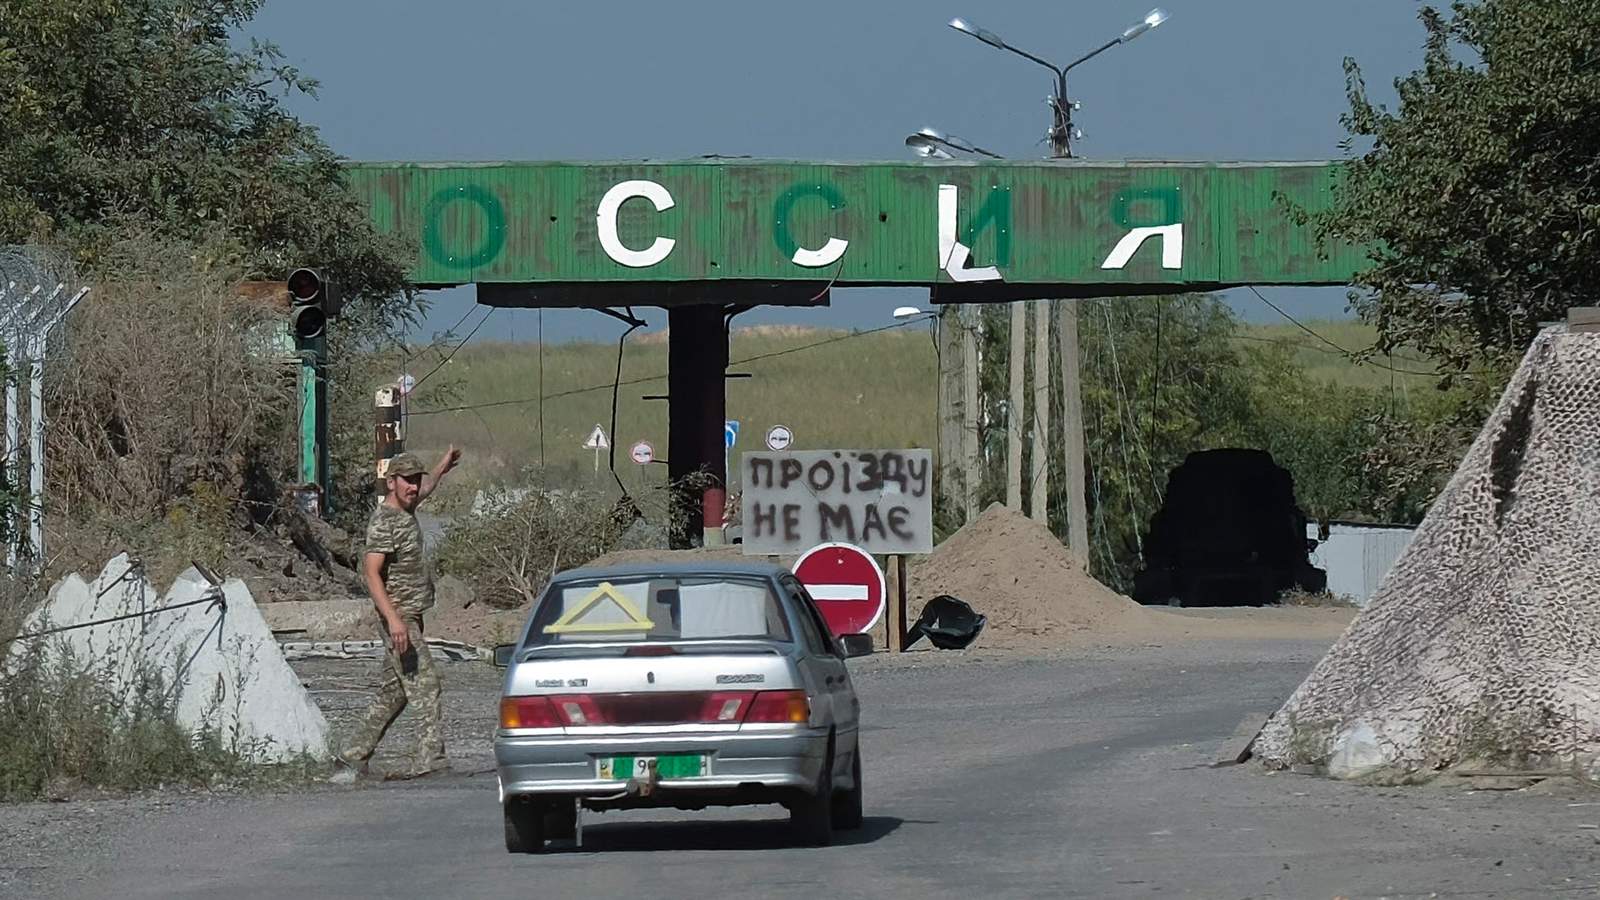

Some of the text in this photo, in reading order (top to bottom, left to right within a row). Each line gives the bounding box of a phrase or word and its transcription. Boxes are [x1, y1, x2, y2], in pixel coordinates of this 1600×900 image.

[751, 451, 928, 498] ПРОЇЗДУ
[754, 502, 914, 542] НЕ МАЄ
